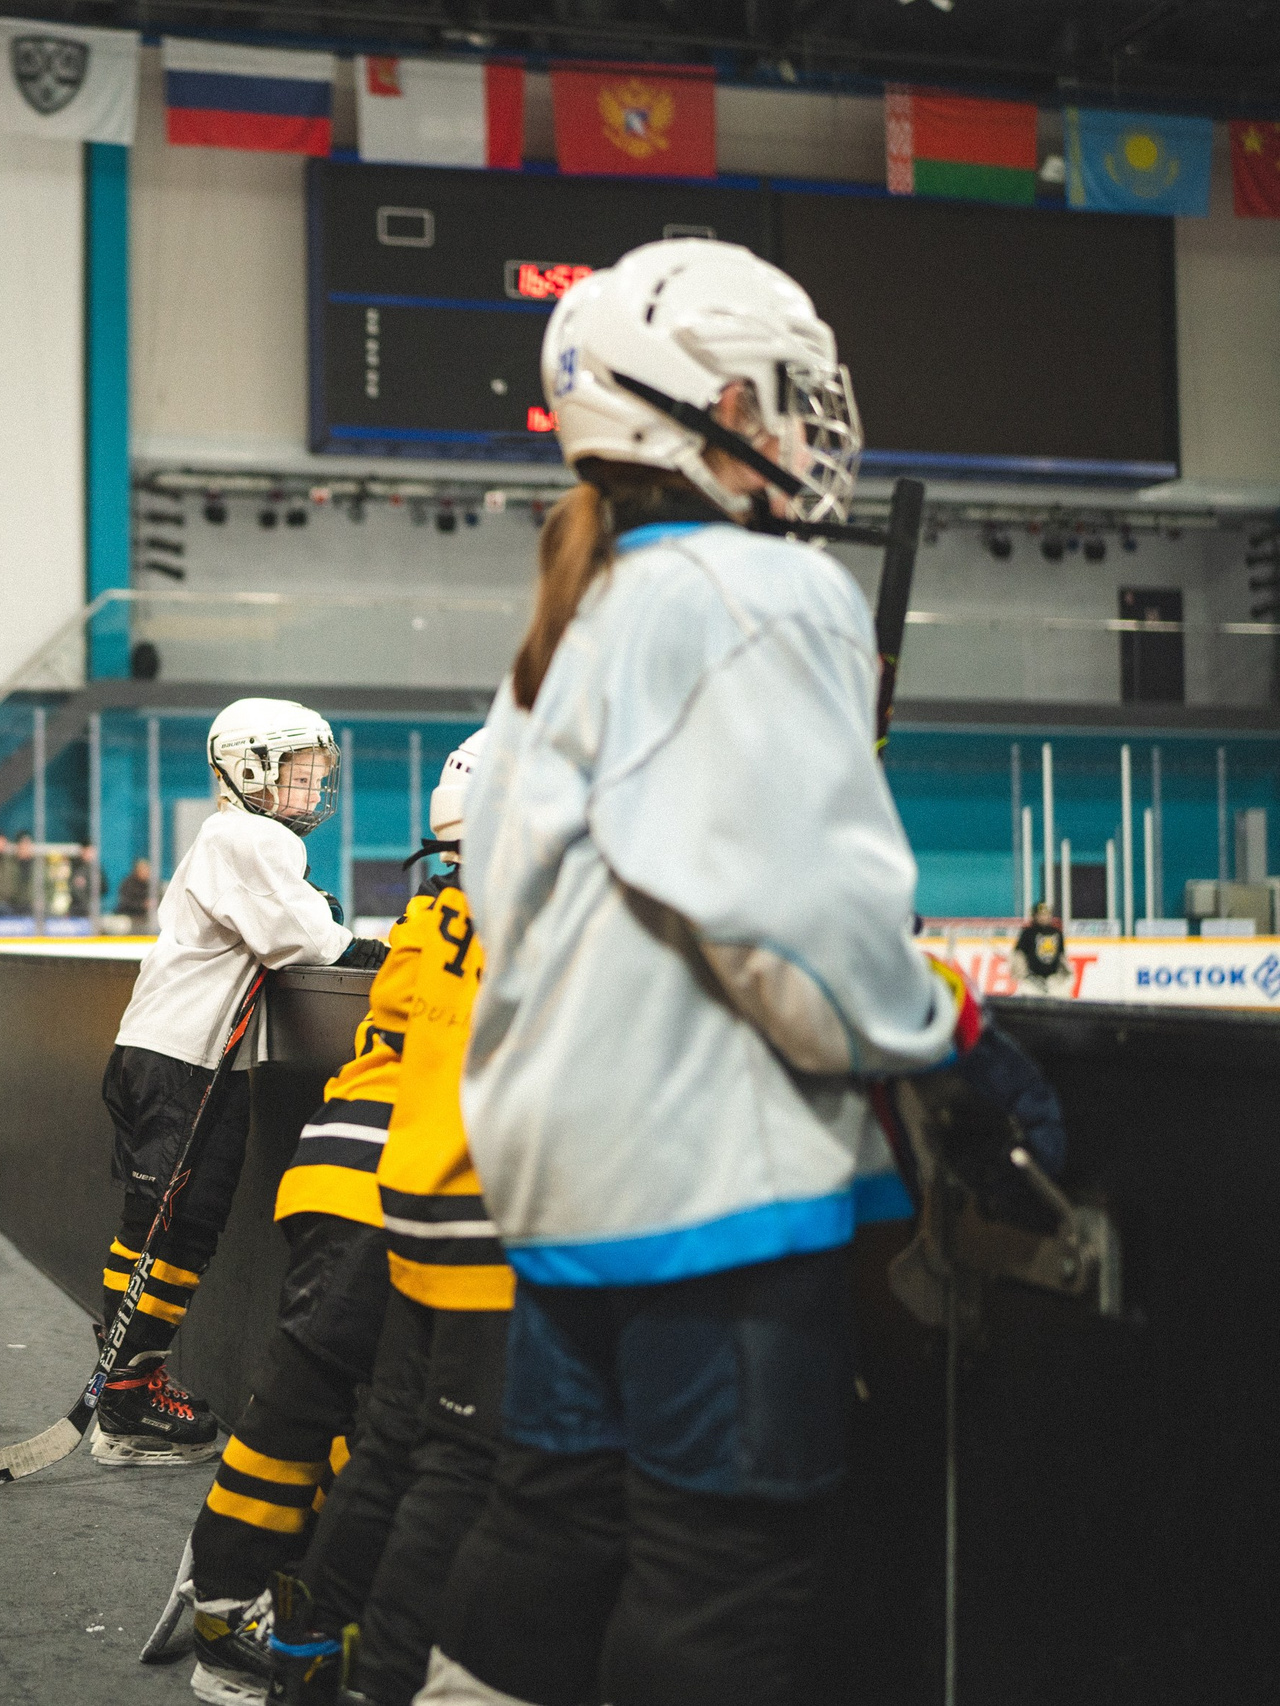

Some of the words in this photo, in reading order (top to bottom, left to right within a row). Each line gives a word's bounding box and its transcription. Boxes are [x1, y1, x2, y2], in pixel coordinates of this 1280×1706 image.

[221, 740, 247, 749] BAUER
[1137, 965, 1247, 987] ВОСТОК
[100, 1252, 154, 1373] BAUER
